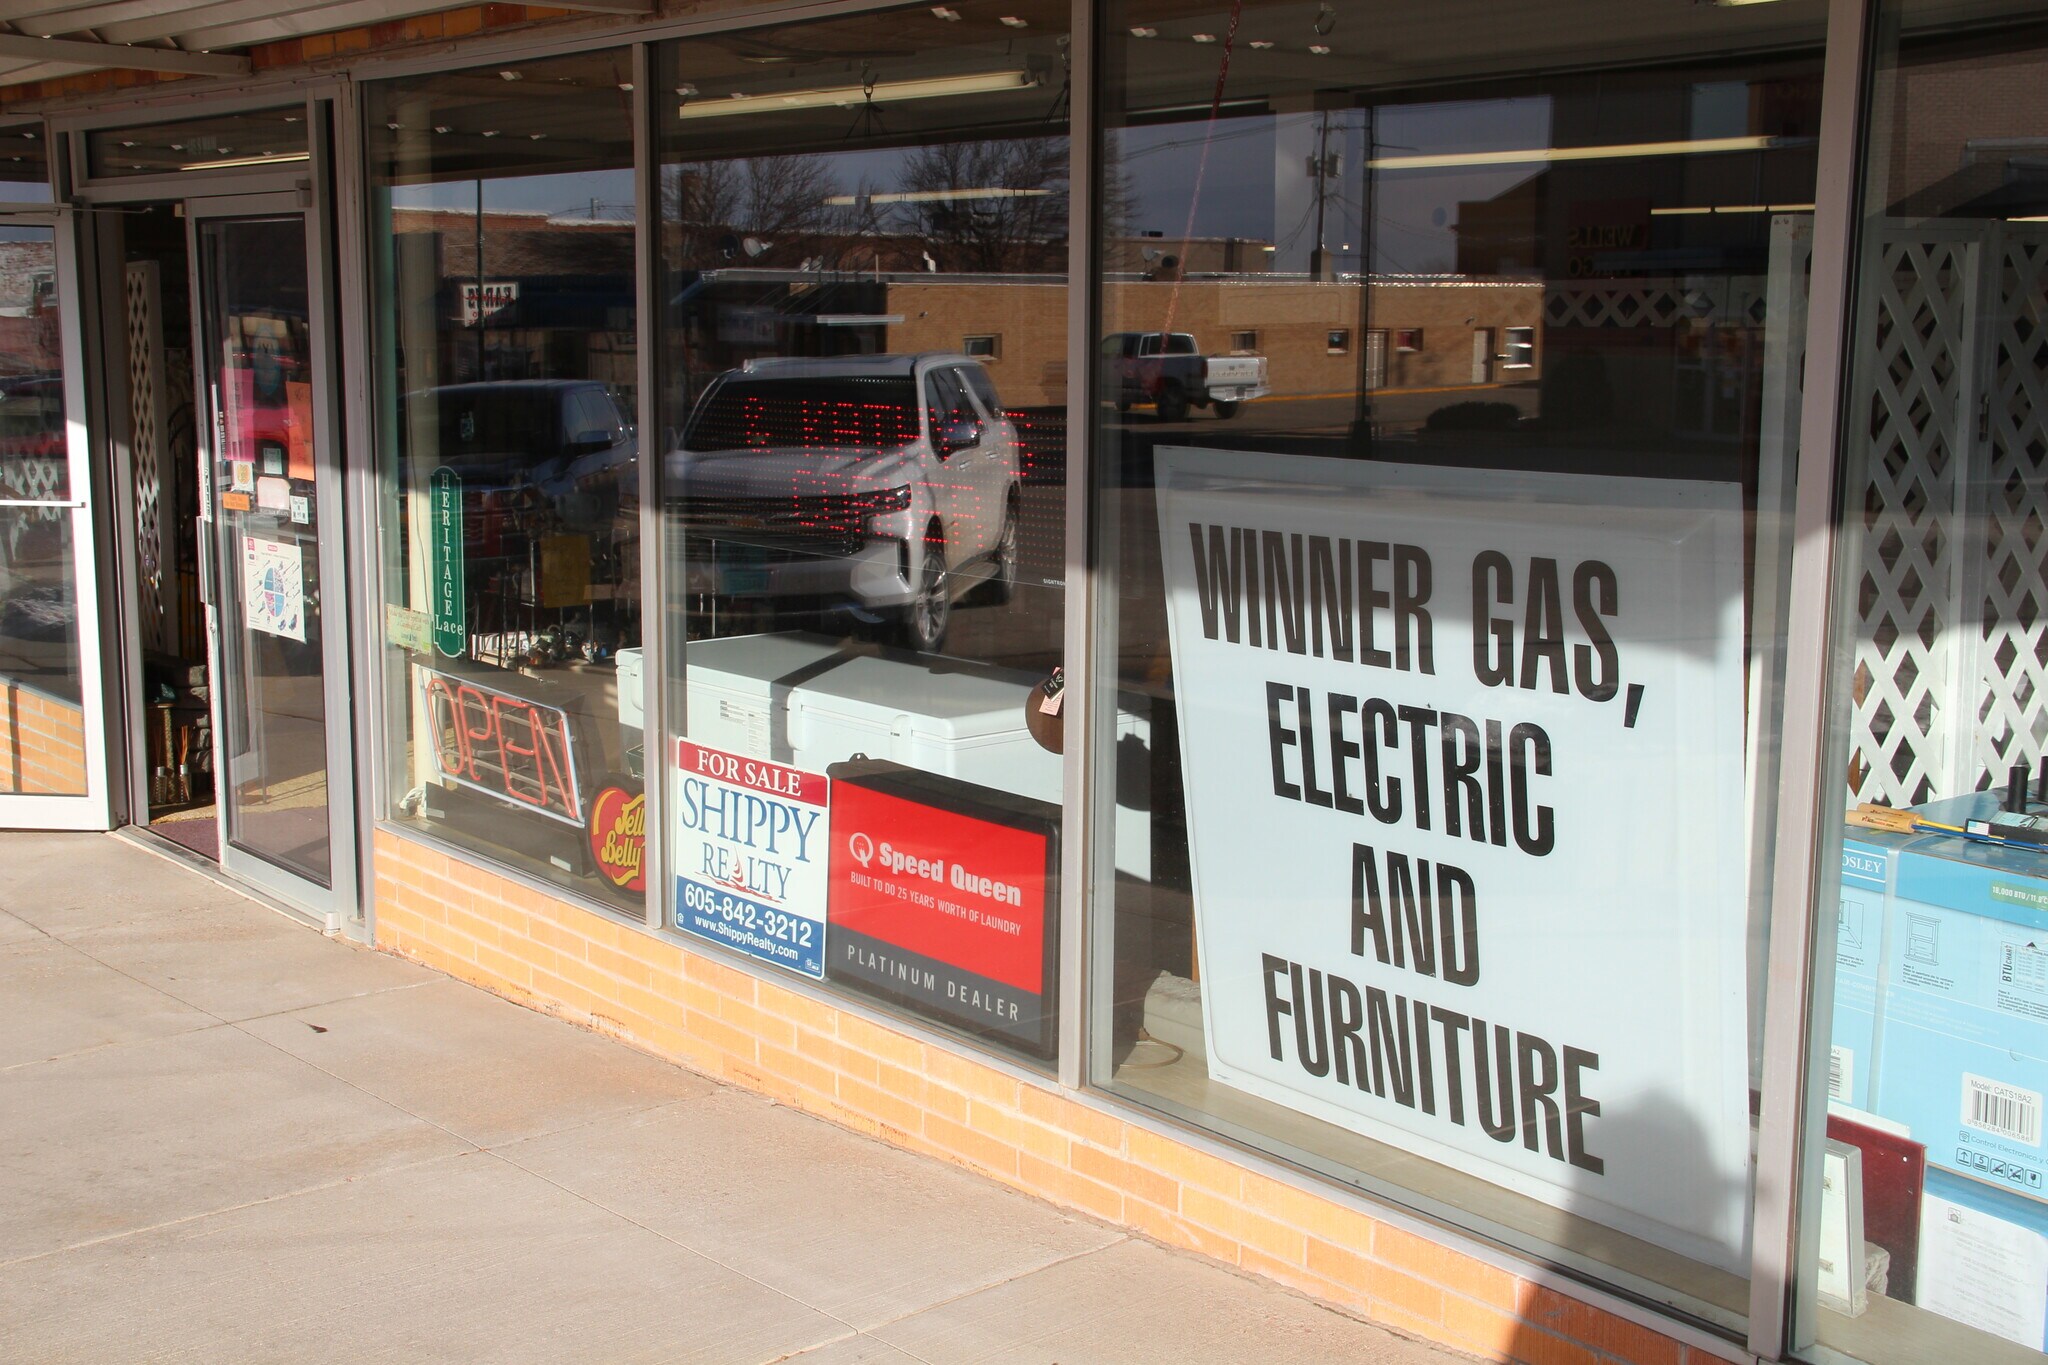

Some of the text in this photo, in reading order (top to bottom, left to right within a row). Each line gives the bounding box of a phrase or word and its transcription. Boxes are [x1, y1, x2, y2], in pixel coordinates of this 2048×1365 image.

[793, 470, 983, 549] CORNER
[441, 473, 453, 617] HERITAGE
[435, 614, 463, 636] Lace
[1189, 522, 1646, 729] WINNER GAS,
[426, 678, 577, 819] OPEN
[697, 749, 802, 797] FOR SALE
[1265, 680, 1556, 857] ELECTRIC
[682, 777, 820, 863] SHIPPY
[601, 830, 642, 886] Belly
[879, 842, 944, 883] Speed
[950, 863, 1021, 907] Queen
[685, 883, 813, 948] 605-842-3212
[851, 871, 1022, 937] BUILT TO DO 25 YEARS WORTH OF LAUNDRY
[1350, 841, 1480, 988] AND
[2014, 890, 2026, 899] BTU
[695, 914, 799, 961] www.ShippyRealty.com
[847, 944, 1019, 1022] PLATINUM DEALER
[1261, 952, 1605, 1177] FURNITURE
[1970, 1079, 2032, 1105] Model: CATS18A2
[1971, 1136, 1997, 1149] Control
[1998, 1144, 2037, 1160] Electronico
